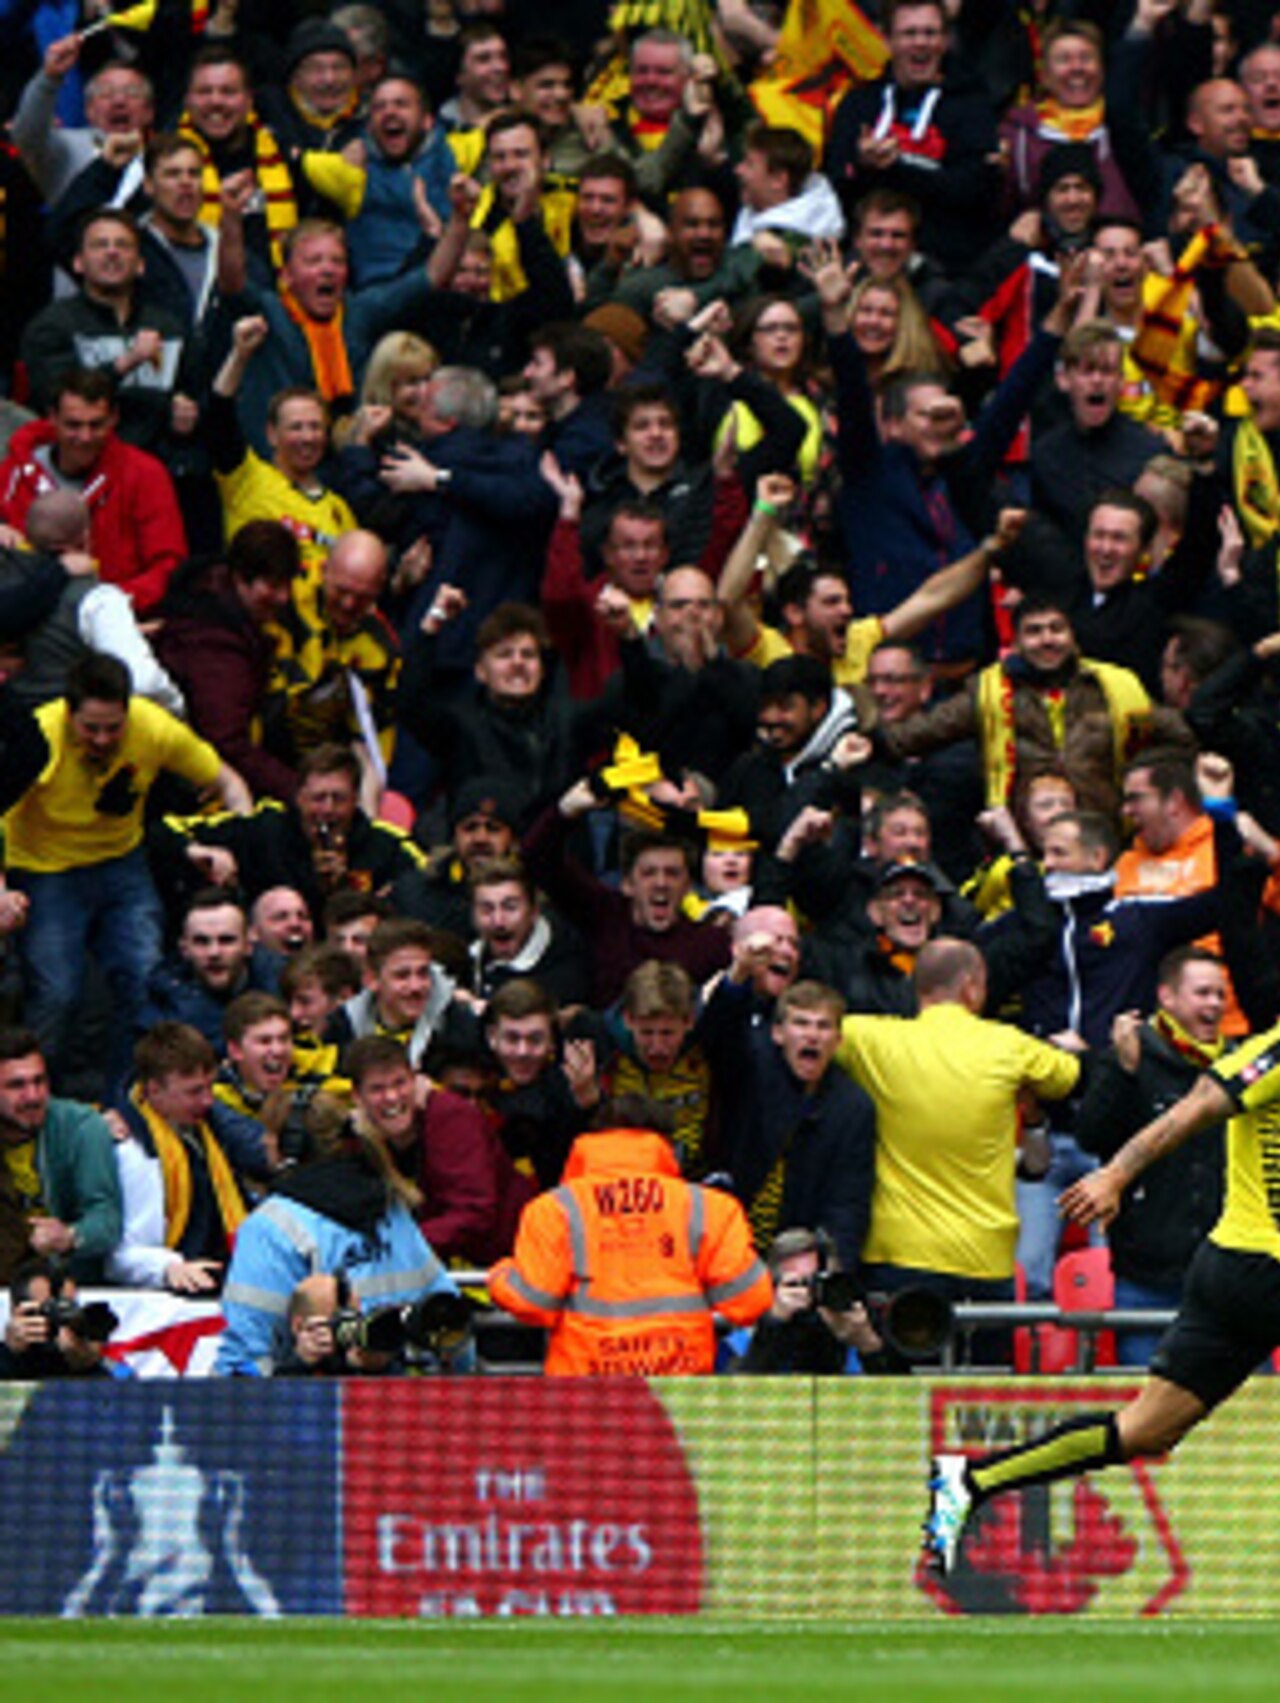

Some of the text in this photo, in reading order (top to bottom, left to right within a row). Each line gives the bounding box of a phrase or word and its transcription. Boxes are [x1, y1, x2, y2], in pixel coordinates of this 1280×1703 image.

[593, 1178, 665, 1216] W260
[476, 1468, 545, 1500] THE
[376, 1510, 652, 1573] Emirates
